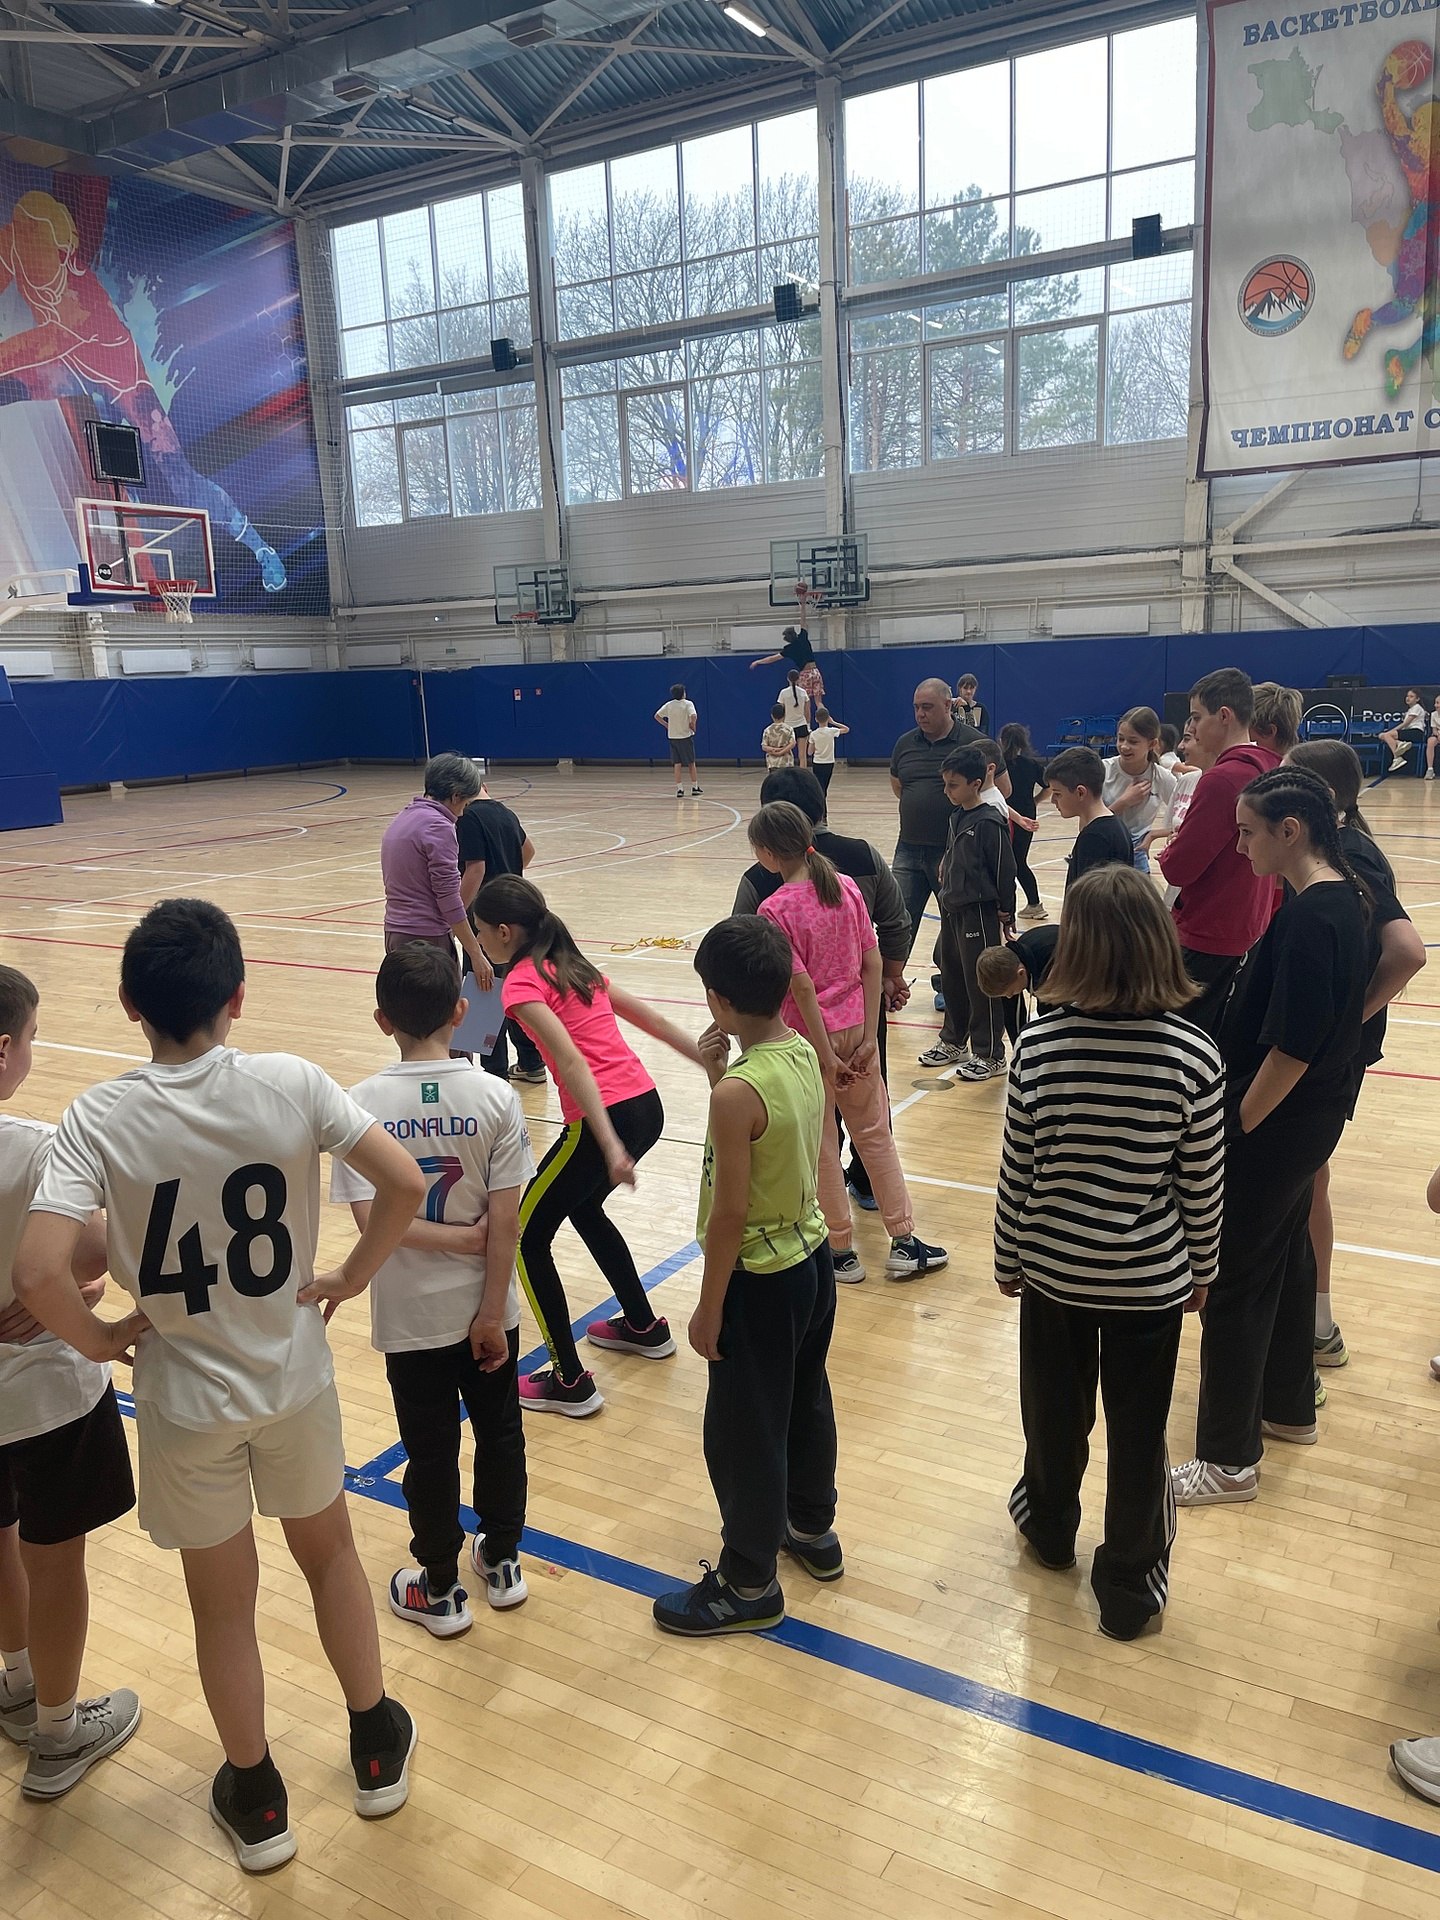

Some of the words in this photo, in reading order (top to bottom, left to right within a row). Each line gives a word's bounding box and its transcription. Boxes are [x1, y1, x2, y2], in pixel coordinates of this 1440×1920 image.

[1231, 410, 1414, 448] ЧЕМПИОНАТ
[383, 1116, 478, 1140] RONALDO
[416, 1155, 465, 1225] 7
[138, 1162, 294, 1317] 48
